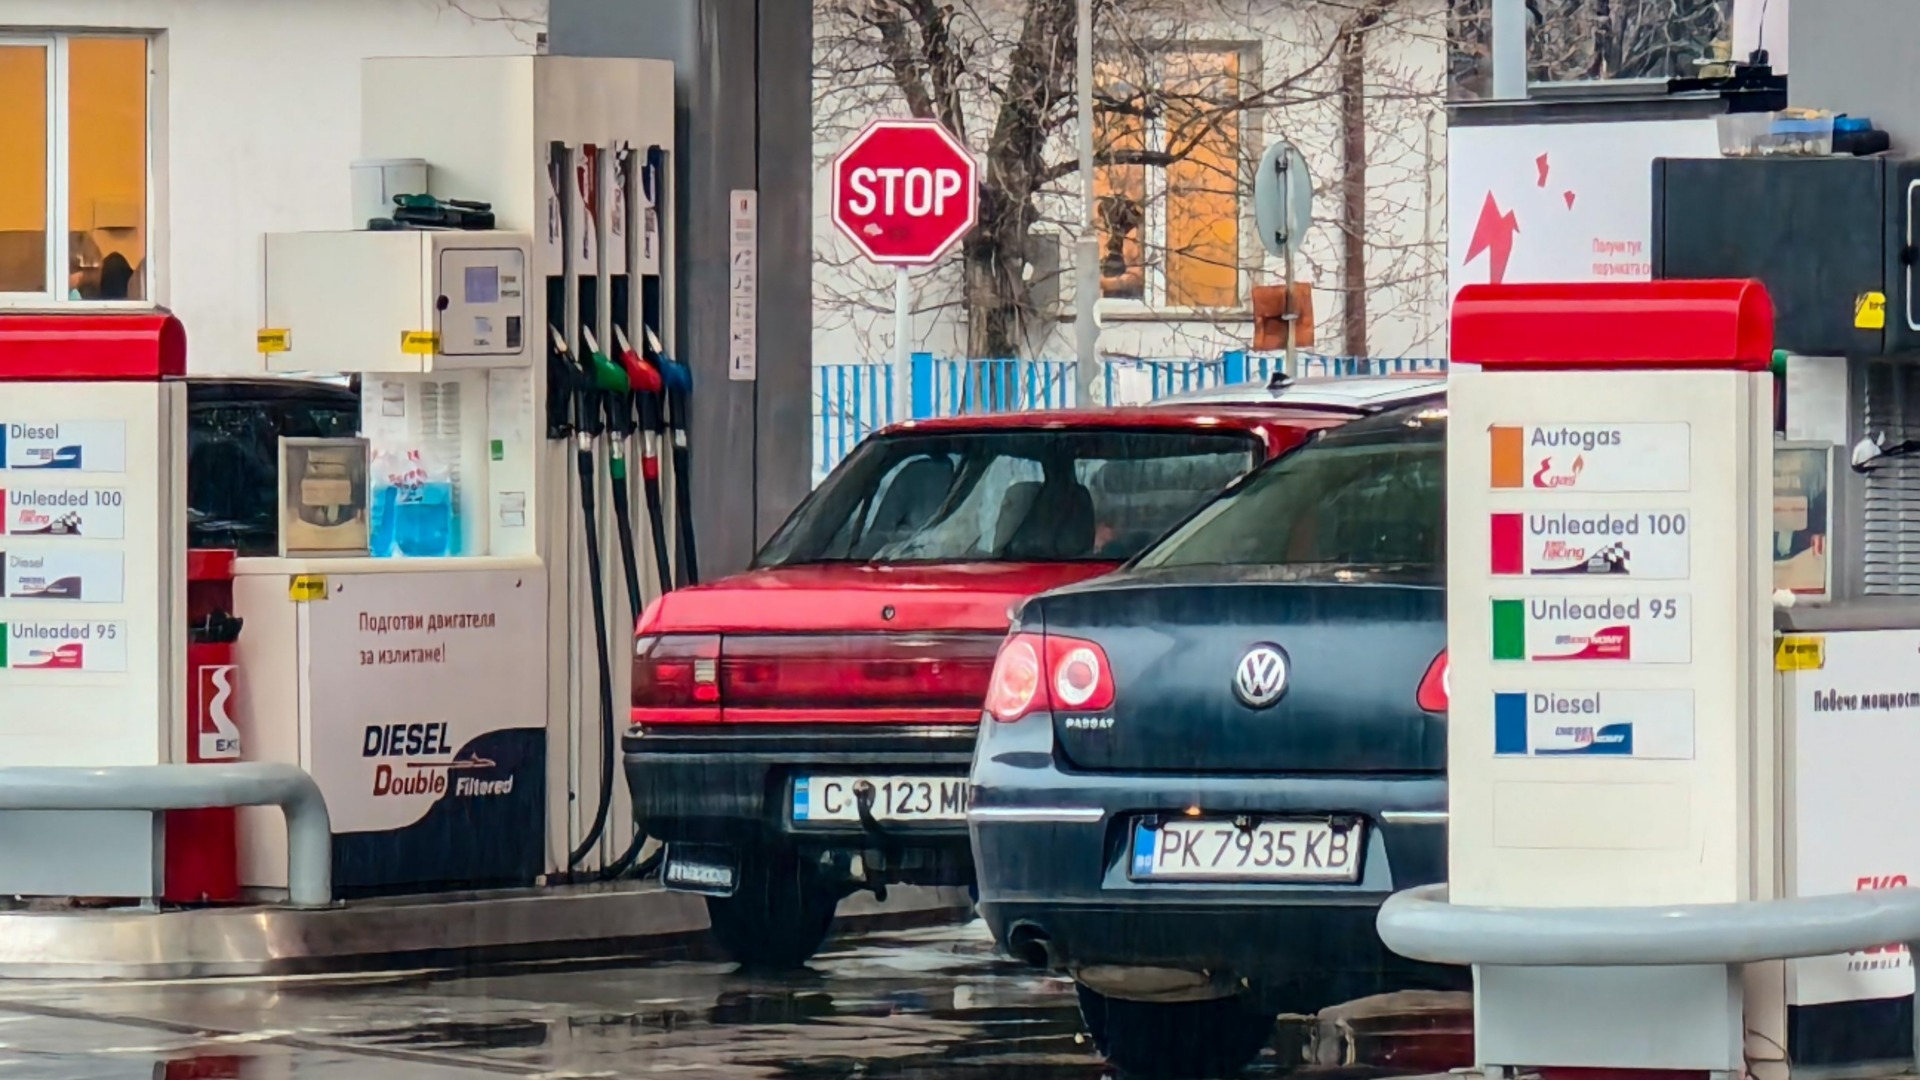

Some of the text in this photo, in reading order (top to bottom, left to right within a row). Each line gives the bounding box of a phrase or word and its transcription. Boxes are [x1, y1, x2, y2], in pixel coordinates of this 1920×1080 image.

[849, 167, 961, 216] STOP
[11, 423, 59, 440] Diesel
[1531, 427, 1621, 451] Autogas
[11, 489, 122, 506] Unleaded 100
[1530, 512, 1686, 535] Unleaded 100
[10, 555, 44, 568] Diesel
[1531, 597, 1677, 620] Unleaded 95
[12, 622, 117, 640] Unleaded 95
[359, 612, 496, 633] Подготви двигателя
[360, 642, 446, 665] за излитане!
[1533, 691, 1601, 714] Diesel
[1814, 688, 1857, 711] Повече
[1065, 718, 1115, 729] PASSAT
[216, 739, 239, 751] EK
[362, 722, 452, 757] DIESEL
[373, 764, 514, 796] Double Filtered
[824, 783, 842, 814] C
[1159, 829, 1349, 867] PK 7935 KB
